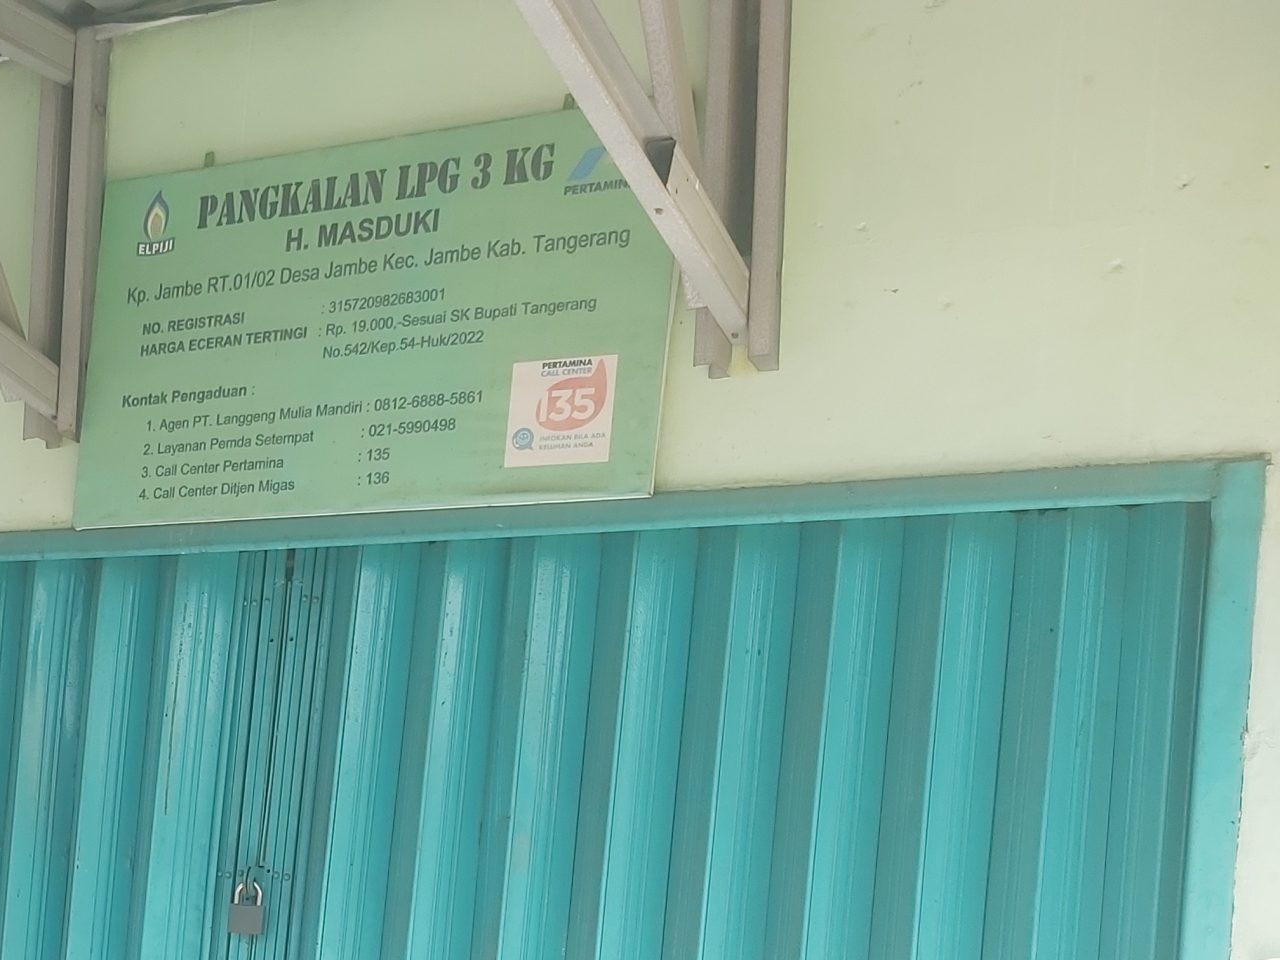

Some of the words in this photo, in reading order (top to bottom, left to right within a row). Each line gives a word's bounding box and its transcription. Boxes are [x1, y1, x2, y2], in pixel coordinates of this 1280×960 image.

[197, 168, 387, 229] PANGKALAN
[395, 156, 461, 201] LPG
[470, 152, 493, 190] 3
[503, 143, 556, 186] KG
[563, 178, 631, 196] PERTAMIN
[138, 239, 174, 256] ELPIJI
[285, 228, 309, 253] H.
[317, 208, 440, 248] MASDUKI
[127, 287, 150, 306] Kp.
[154, 278, 202, 301] Jambe
[207, 269, 276, 294] RT.01/02
[280, 266, 320, 285] Desa
[324, 257, 378, 279] Jambe
[382, 253, 418, 271] Kec.
[424, 245, 481, 266] Jambe
[486, 239, 525, 259] Kab.
[533, 229, 631, 255] Tangerang
[140, 341, 185, 357] HARGA
[188, 333, 242, 351] ECERAN
[246, 327, 308, 345] TERTINGI
[325, 322, 347, 338] Rp.
[450, 307, 470, 323] SK
[474, 304, 517, 321] Bupati
[522, 298, 597, 316] Tangerang
[142, 322, 164, 336] NO.
[167, 312, 245, 332] REGISTRASI
[328, 287, 446, 315] 315720982683001
[541, 368, 560, 377] CALL
[562, 367, 593, 376] CENTER
[542, 359, 593, 370] PERTAMINA
[122, 391, 168, 408] Kontak
[171, 386, 247, 404] Pengaduan
[159, 418, 190, 433] Agen
[192, 415, 213, 428] PT.
[216, 410, 276, 427] Langgeng
[279, 405, 312, 420] Mulia
[316, 401, 363, 417] Mandiri
[374, 390, 484, 412] 0812-6888-5861
[539, 387, 596, 422] 135
[157, 440, 207, 456] Layanan
[210, 435, 252, 450] Pemda
[255, 430, 314, 448] Setempat
[368, 418, 456, 437] 021-5990498
[155, 464, 177, 477] Call
[180, 462, 220, 475] Center
[223, 457, 284, 472] Pertamina
[366, 447, 390, 461] 135
[153, 486, 175, 499] Call
[178, 484, 218, 498] Center
[221, 481, 255, 497] Ditjen
[258, 479, 295, 495] Migas
[366, 471, 390, 485] 136
